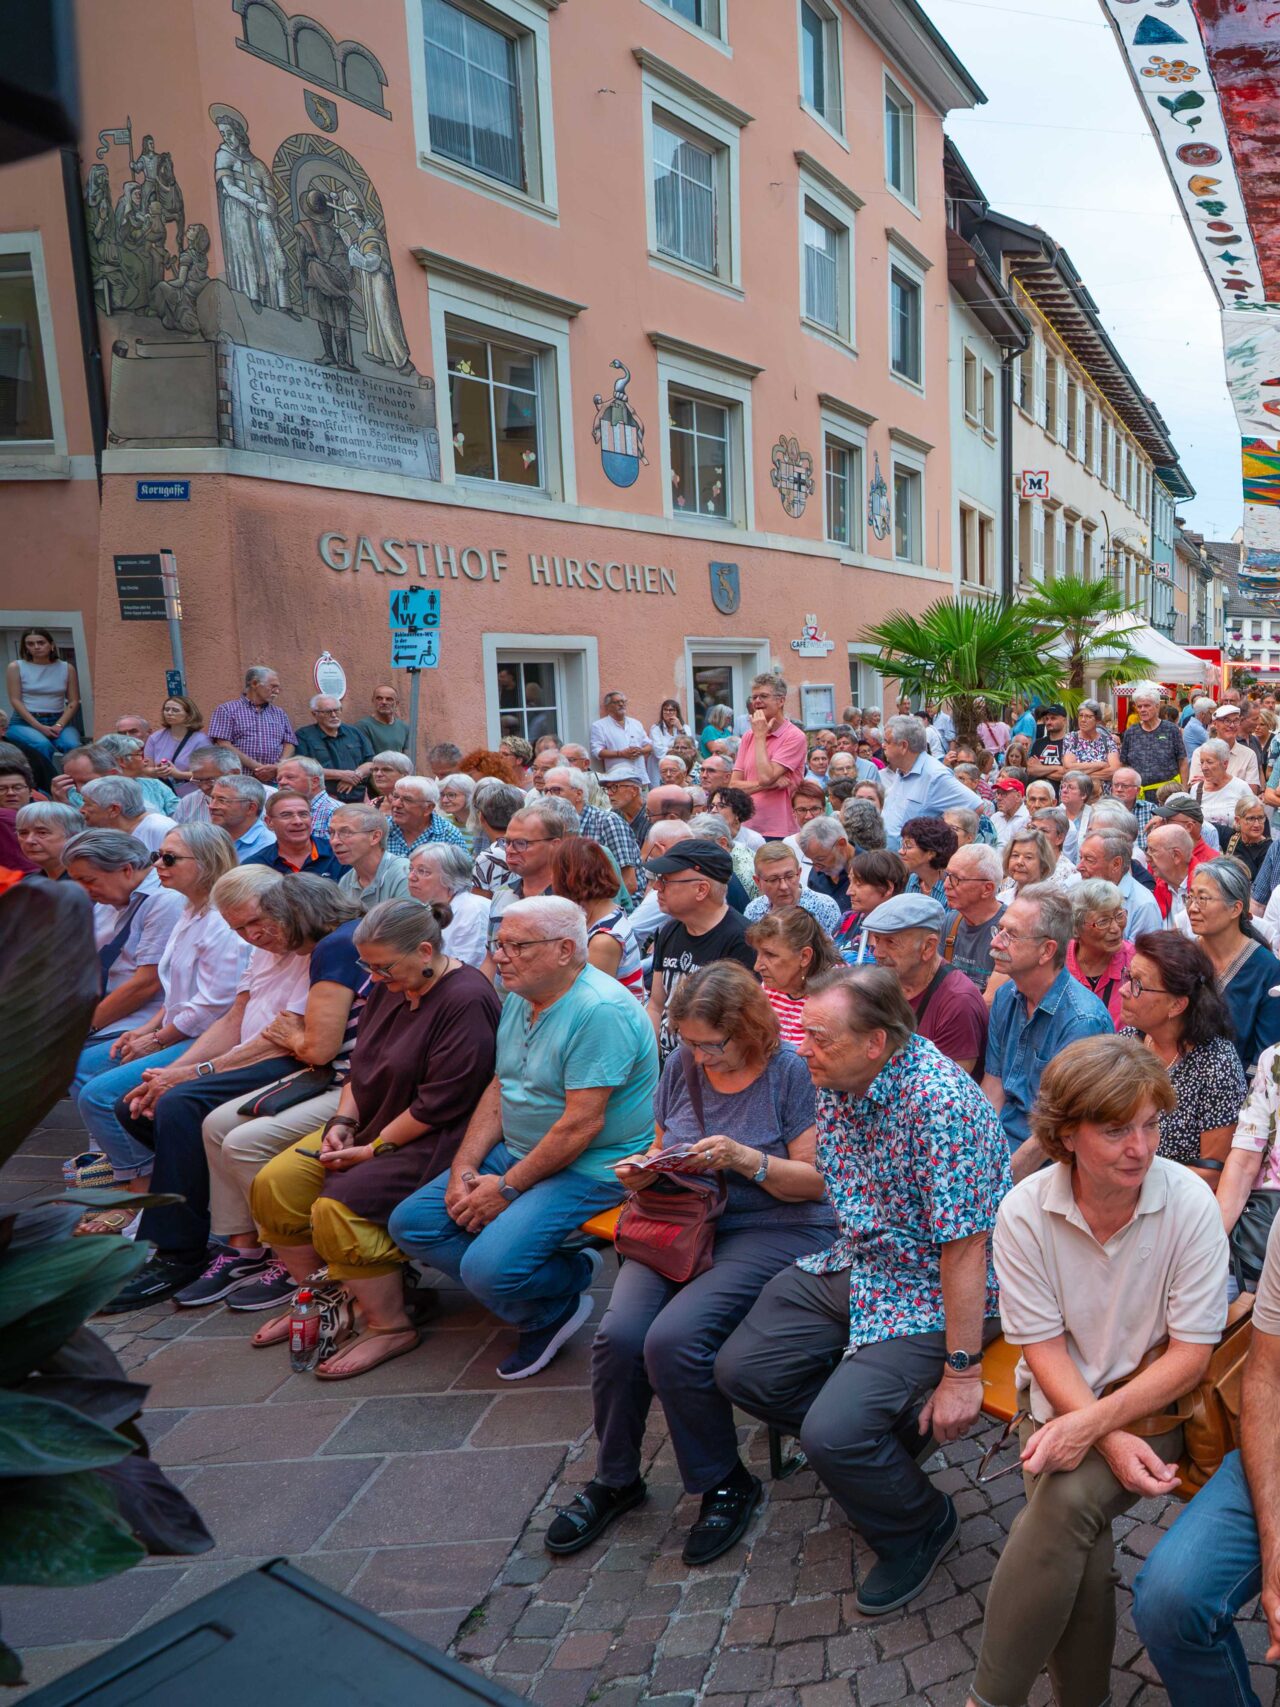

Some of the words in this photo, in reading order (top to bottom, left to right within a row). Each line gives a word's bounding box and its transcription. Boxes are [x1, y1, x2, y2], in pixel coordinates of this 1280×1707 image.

[249, 378, 313, 401] Clairvaux
[318, 531, 507, 583] GASTHOF
[529, 553, 677, 595] HIRSCHEN
